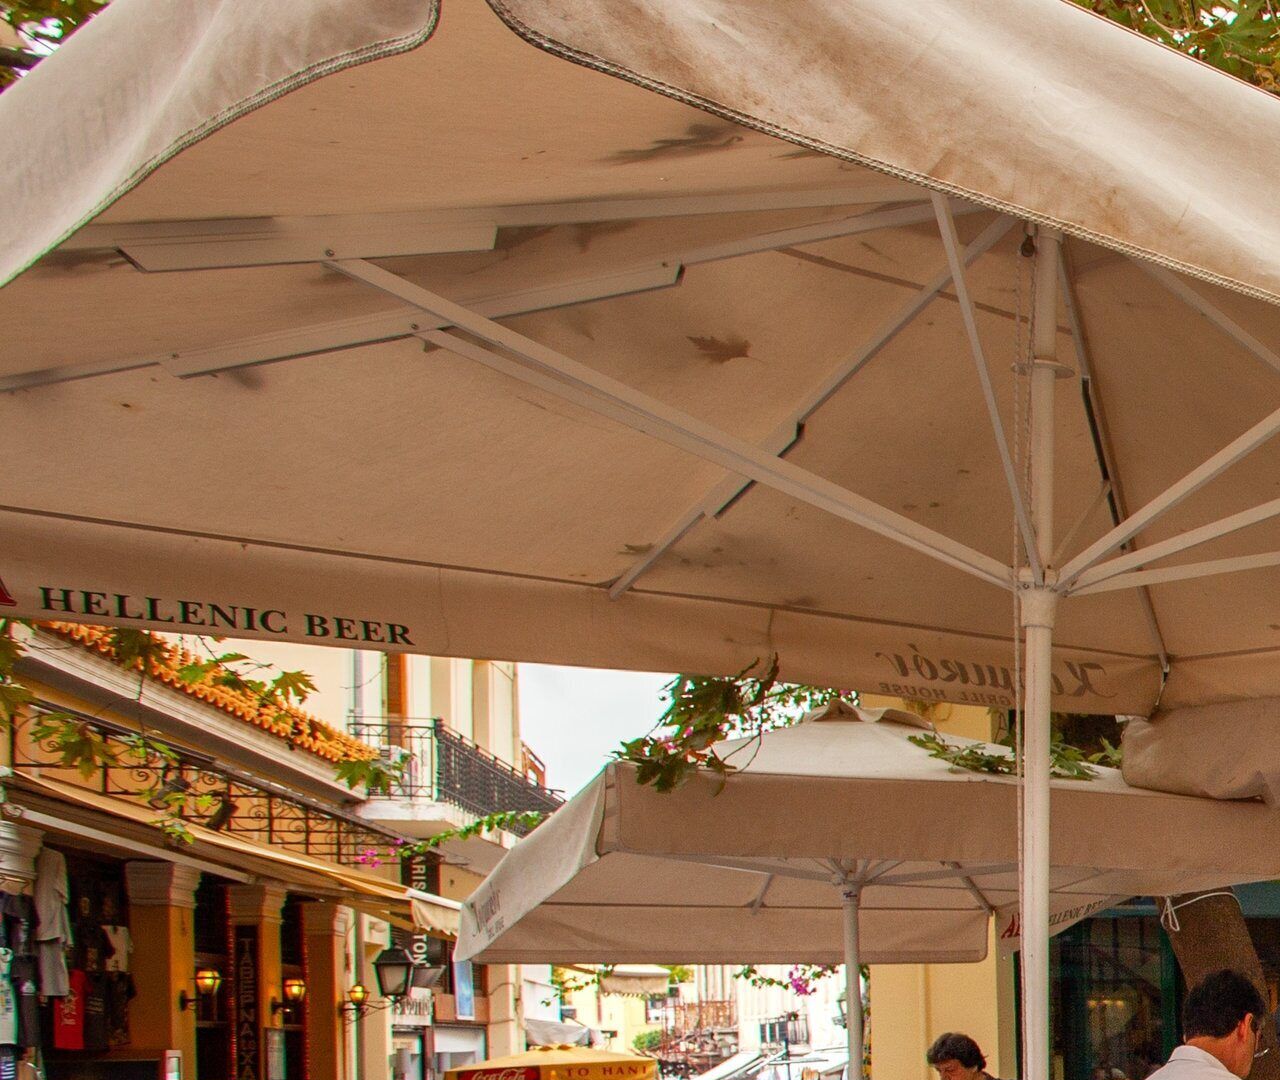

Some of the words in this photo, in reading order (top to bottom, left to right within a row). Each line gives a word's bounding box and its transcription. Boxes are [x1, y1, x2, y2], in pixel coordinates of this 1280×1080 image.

[39, 586, 288, 634] HELLENIC
[305, 613, 416, 646] BEER
[565, 1067, 590, 1078] TO
